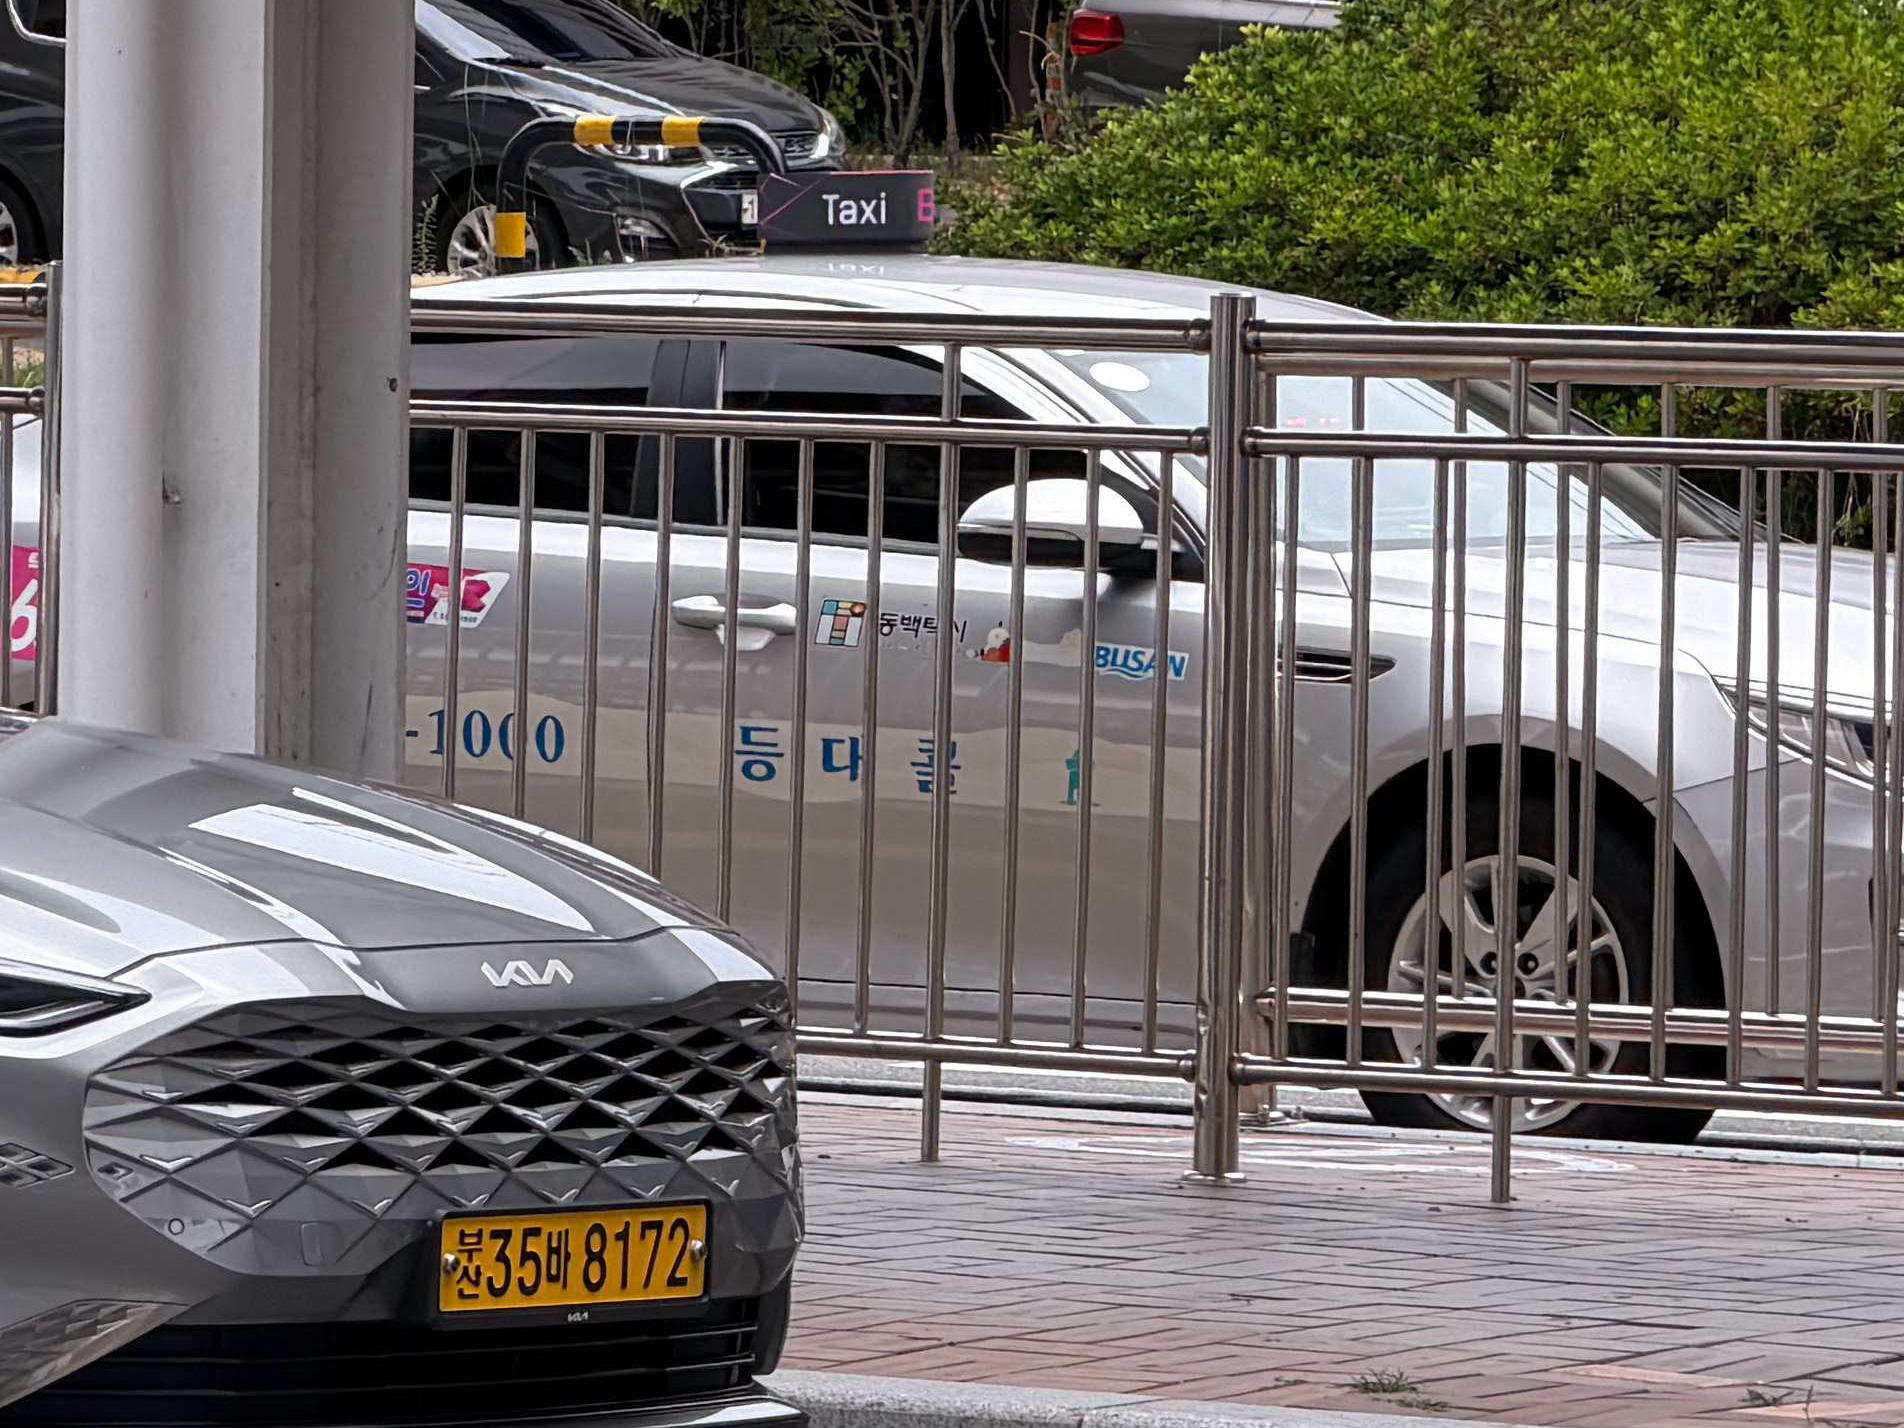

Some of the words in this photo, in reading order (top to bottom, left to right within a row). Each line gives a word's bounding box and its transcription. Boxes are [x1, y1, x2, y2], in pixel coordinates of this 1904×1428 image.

[822, 191, 887, 226] Taxi
[481, 958, 574, 987] KIA
[456, 1227, 483, 1300] 부산
[486, 1226, 571, 1299] 35바
[582, 1216, 691, 1293] 8172
